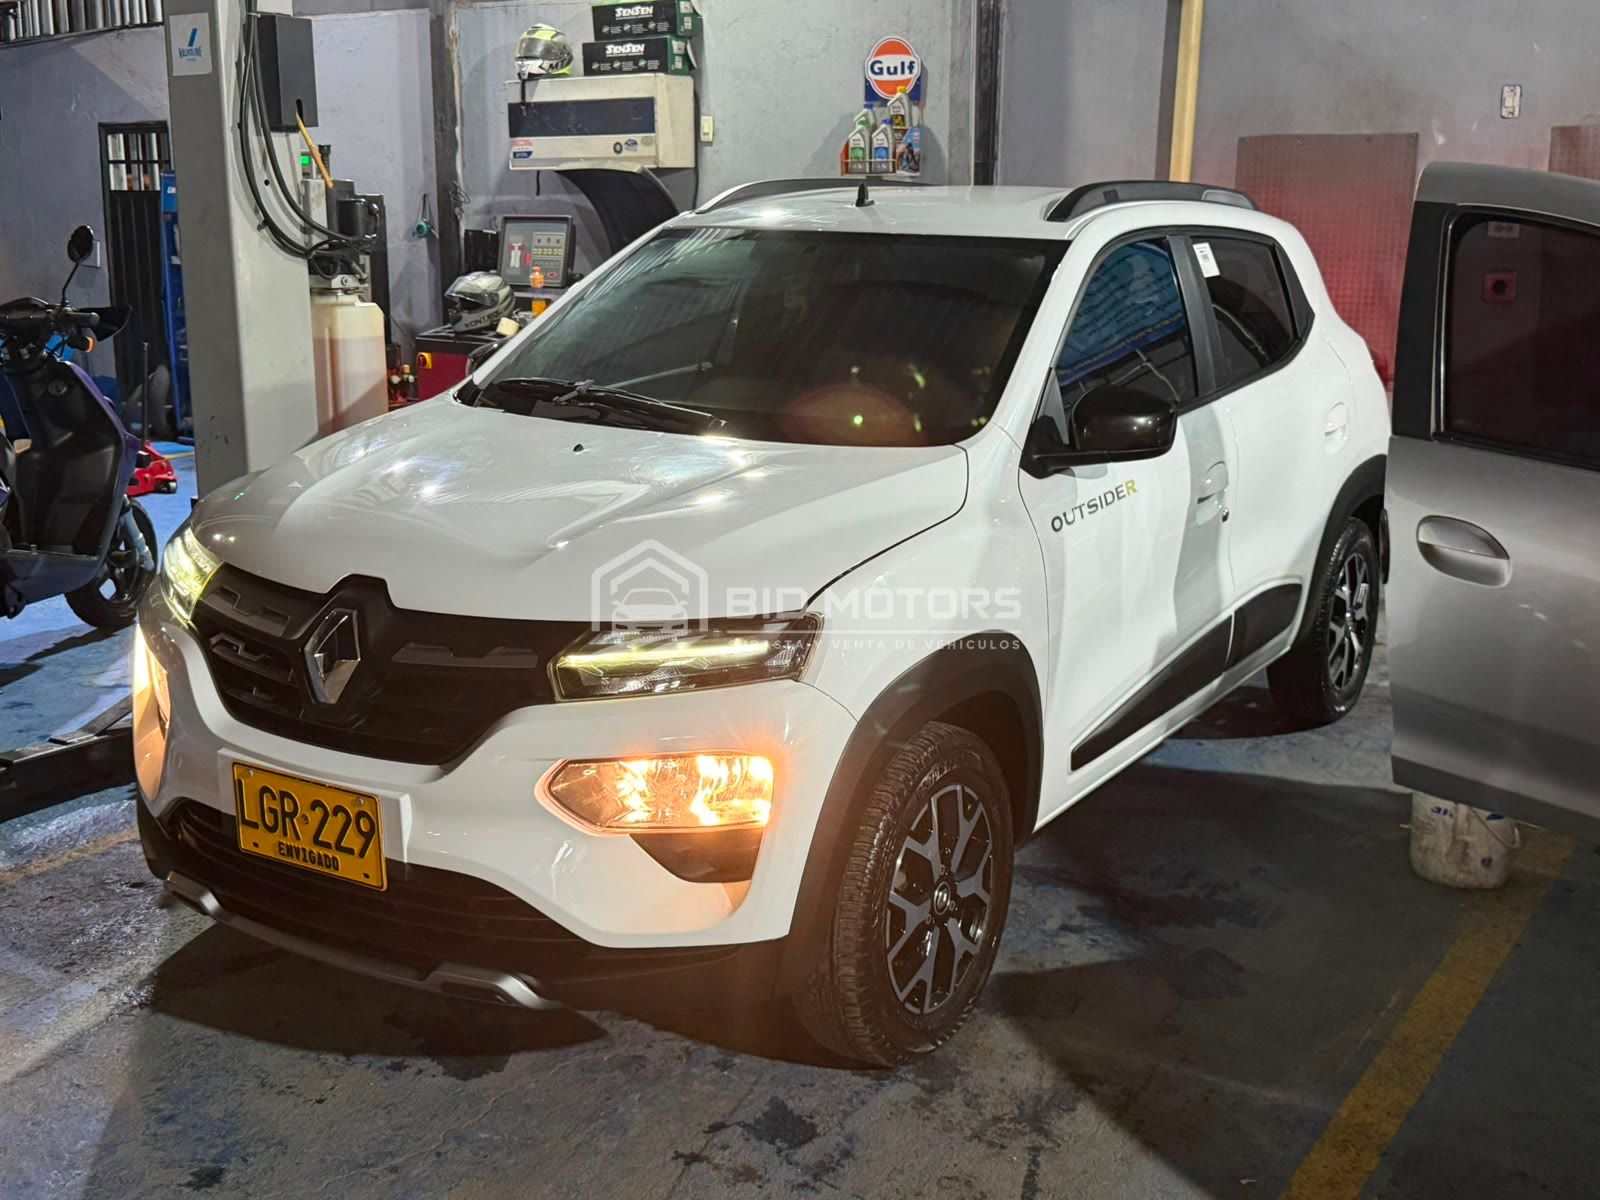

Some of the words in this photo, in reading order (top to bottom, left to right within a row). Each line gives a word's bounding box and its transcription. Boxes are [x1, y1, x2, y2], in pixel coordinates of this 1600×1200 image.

[870, 60, 916, 76] Gulf
[1051, 479, 1137, 533] OUTSIDER
[277, 841, 341, 871] ENVIGADO
